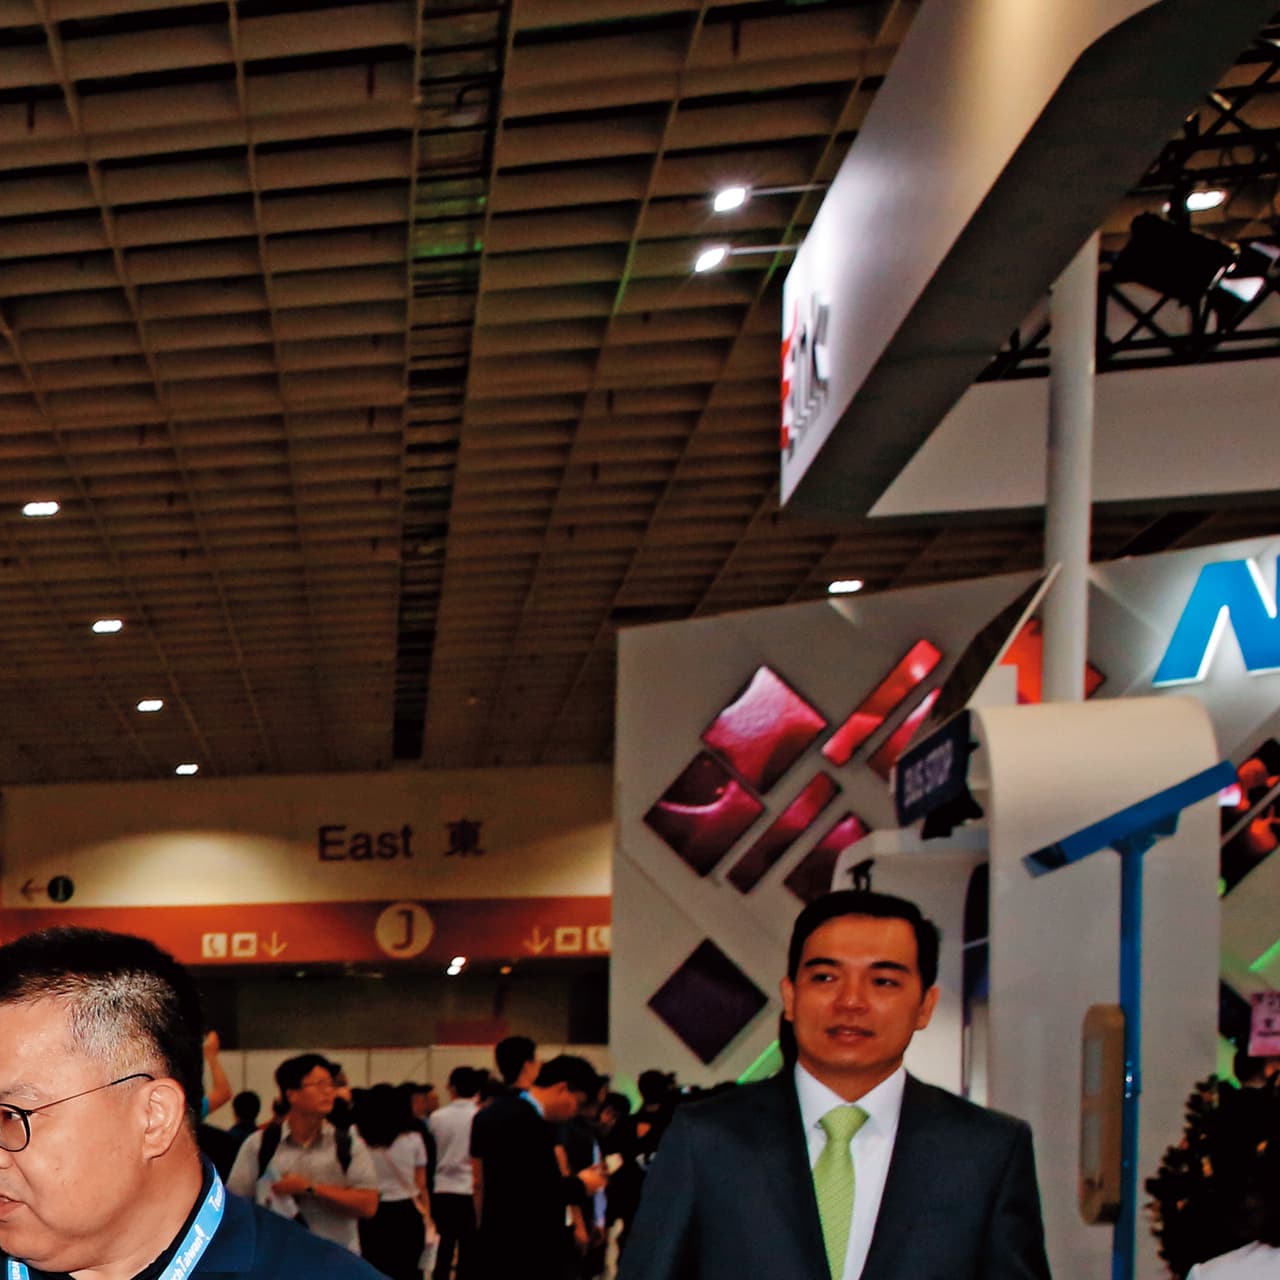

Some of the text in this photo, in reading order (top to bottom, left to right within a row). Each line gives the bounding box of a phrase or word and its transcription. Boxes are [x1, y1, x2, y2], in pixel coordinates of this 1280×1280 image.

[318, 824, 414, 862] East
[444, 817, 486, 857] 東
[392, 909, 415, 950] J
